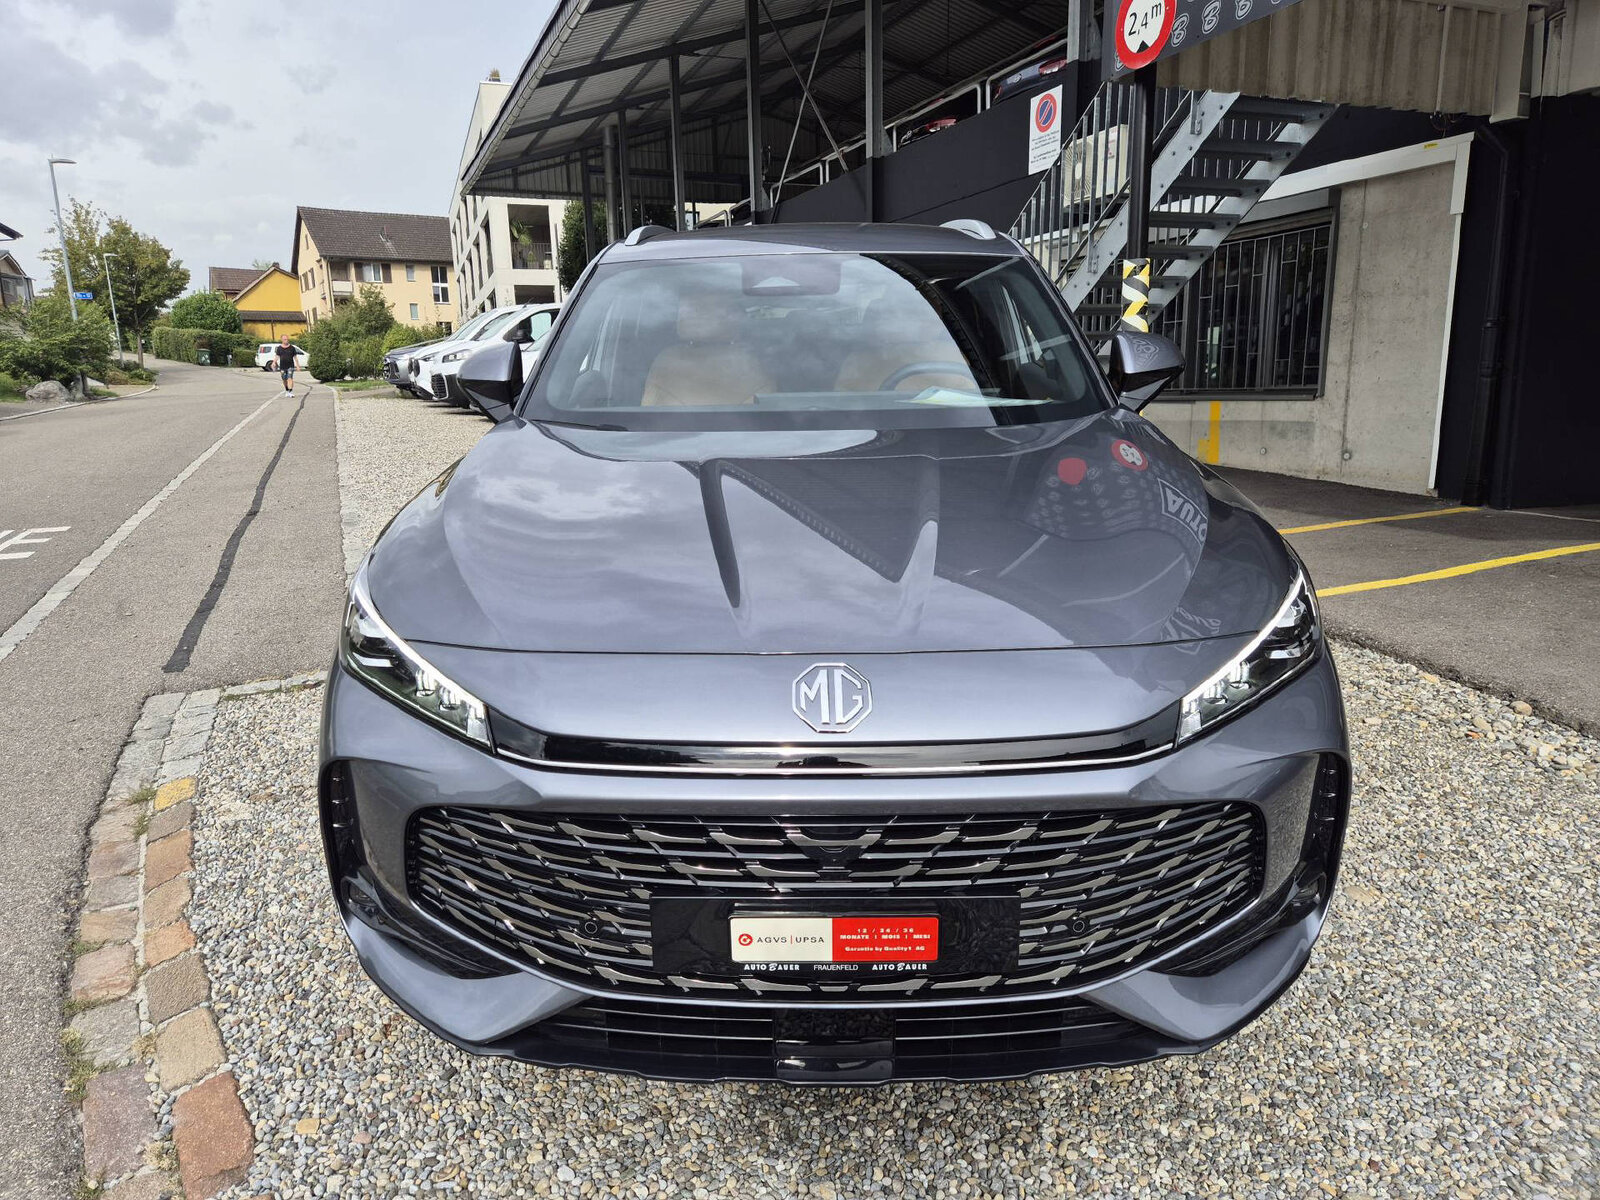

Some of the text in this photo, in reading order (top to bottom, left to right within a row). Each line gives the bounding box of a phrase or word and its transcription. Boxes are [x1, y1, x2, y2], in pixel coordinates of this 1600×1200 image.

[800, 669, 864, 724] MG
[757, 936, 825, 944] AGVS UPSA
[768, 963, 800, 971] BAUER
[896, 963, 928, 971] BAUER
